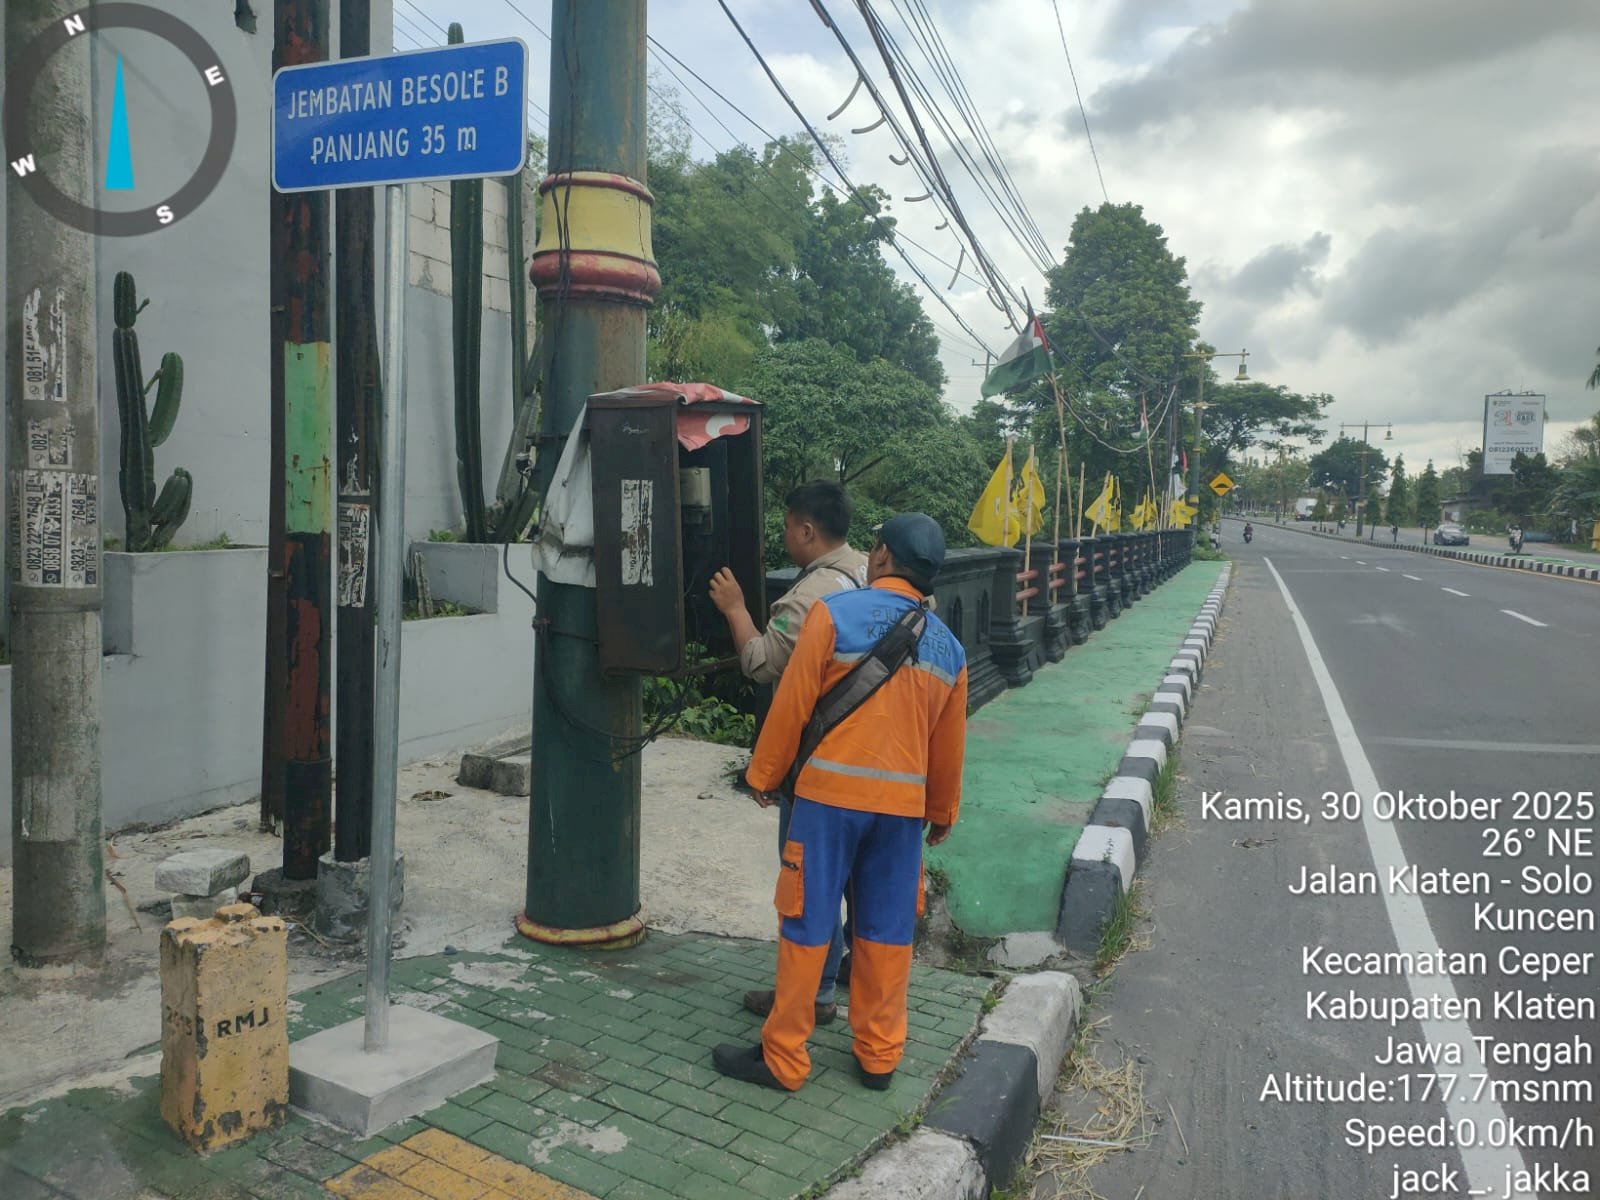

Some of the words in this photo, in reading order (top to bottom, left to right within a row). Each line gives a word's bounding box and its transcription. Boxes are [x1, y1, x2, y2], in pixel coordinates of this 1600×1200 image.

[288, 79, 392, 120] JEMBATAN
[401, 68, 485, 106] BESOLE
[494, 66, 509, 97] B
[312, 127, 410, 165] PANJANG
[420, 125, 446, 155] 35
[457, 125, 477, 152] m
[217, 1007, 269, 1038] RMJ
